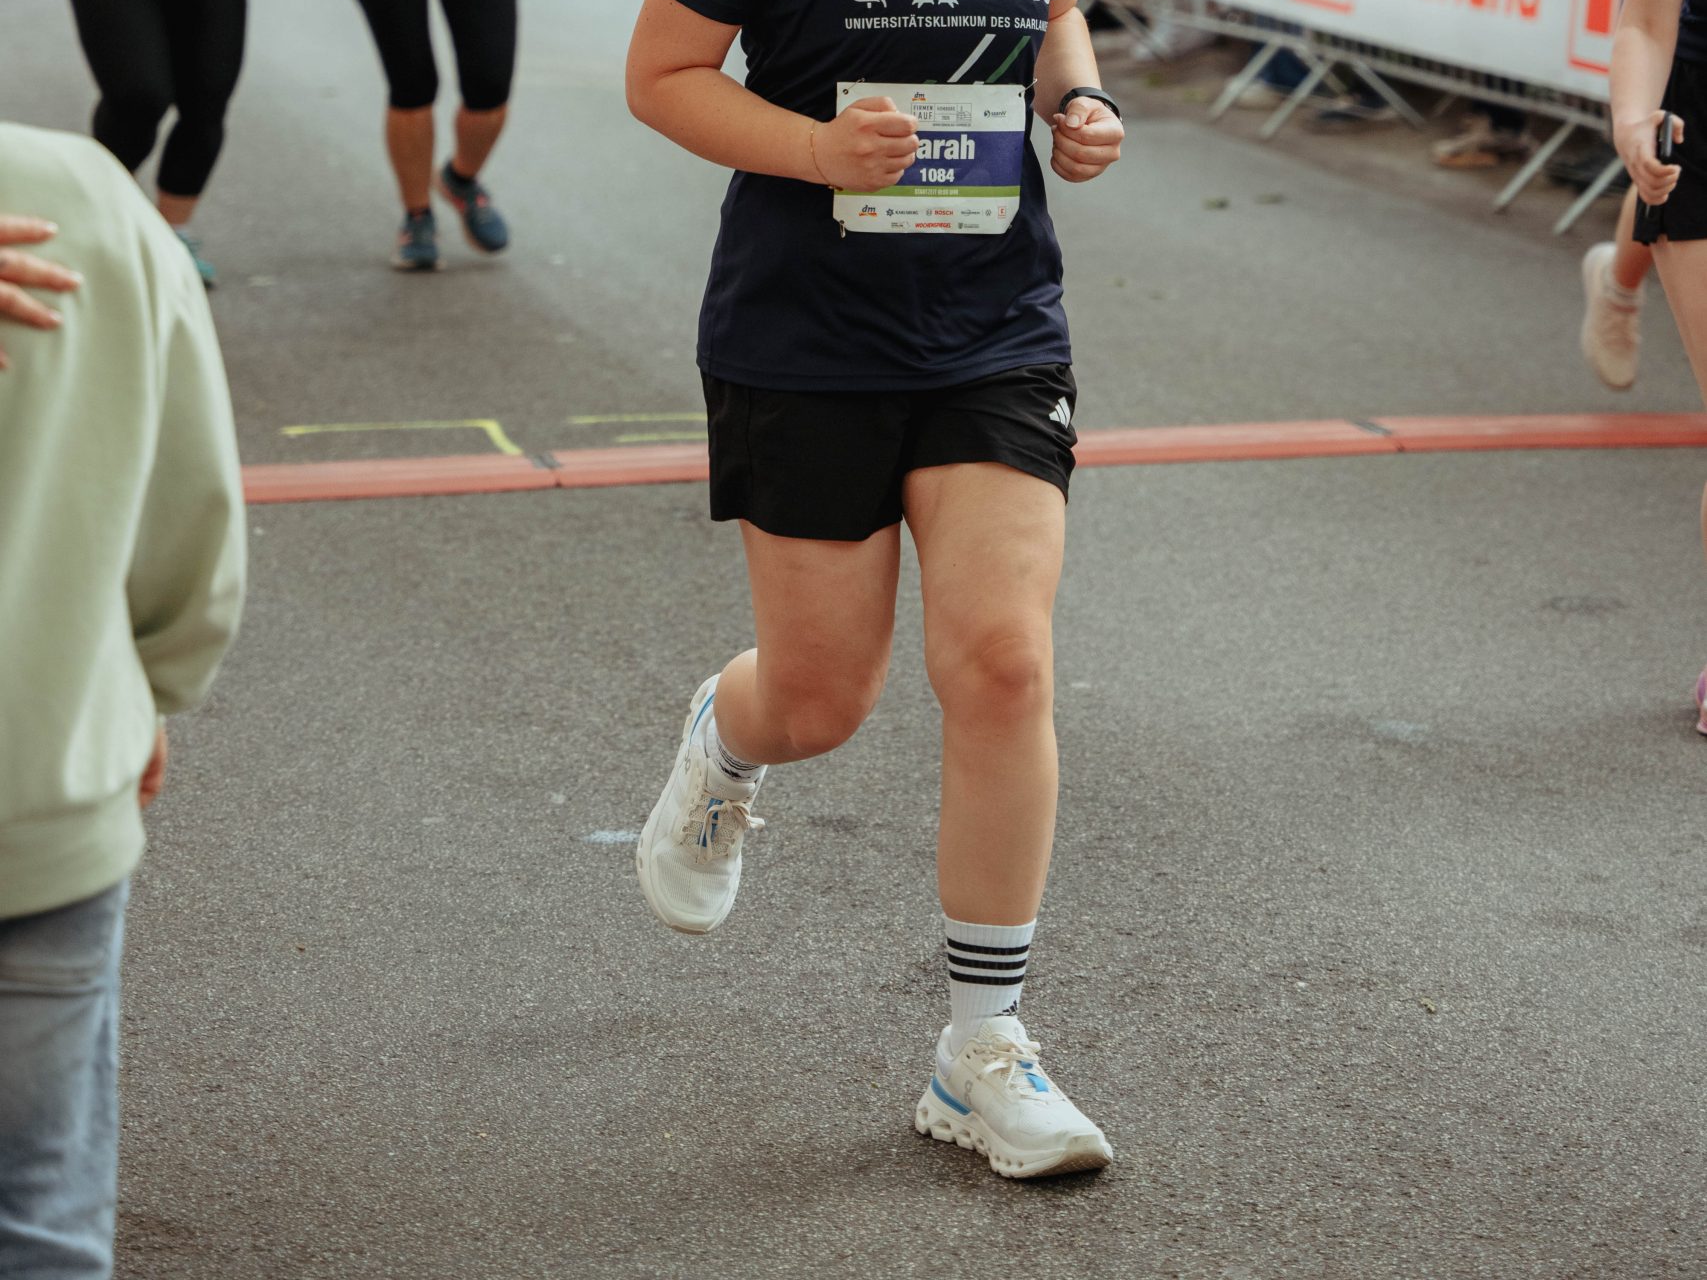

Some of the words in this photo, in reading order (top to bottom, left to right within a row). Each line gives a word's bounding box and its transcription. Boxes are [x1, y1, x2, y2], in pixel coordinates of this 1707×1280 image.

[844, 14, 987, 30] UNIVERSITÄTSKLINIKUM
[990, 16, 1011, 29] DES
[915, 134, 976, 160] arah
[919, 167, 955, 183] 1084
[862, 204, 876, 213] dm
